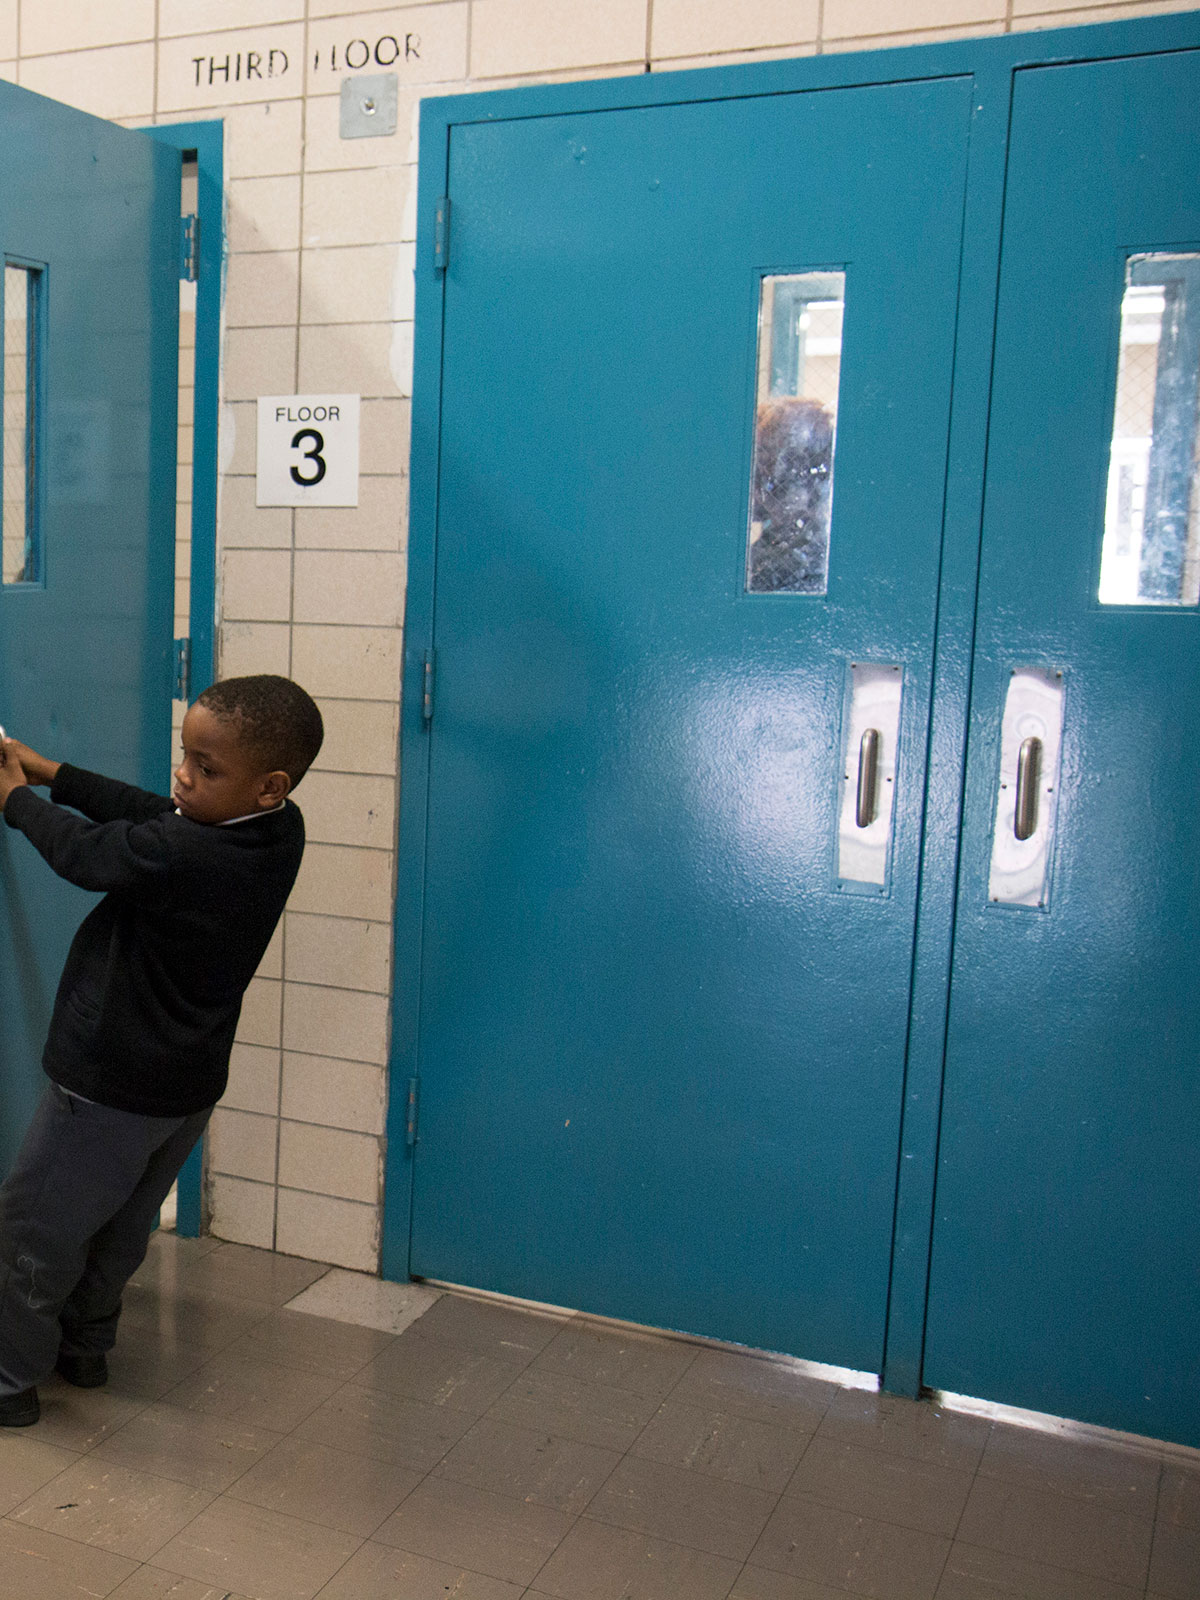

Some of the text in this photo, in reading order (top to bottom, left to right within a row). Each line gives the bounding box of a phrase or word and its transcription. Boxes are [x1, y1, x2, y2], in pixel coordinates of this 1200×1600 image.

[191, 49, 289, 87] THIRD
[275, 406, 340, 422] FLOOR
[289, 428, 326, 487] 3
